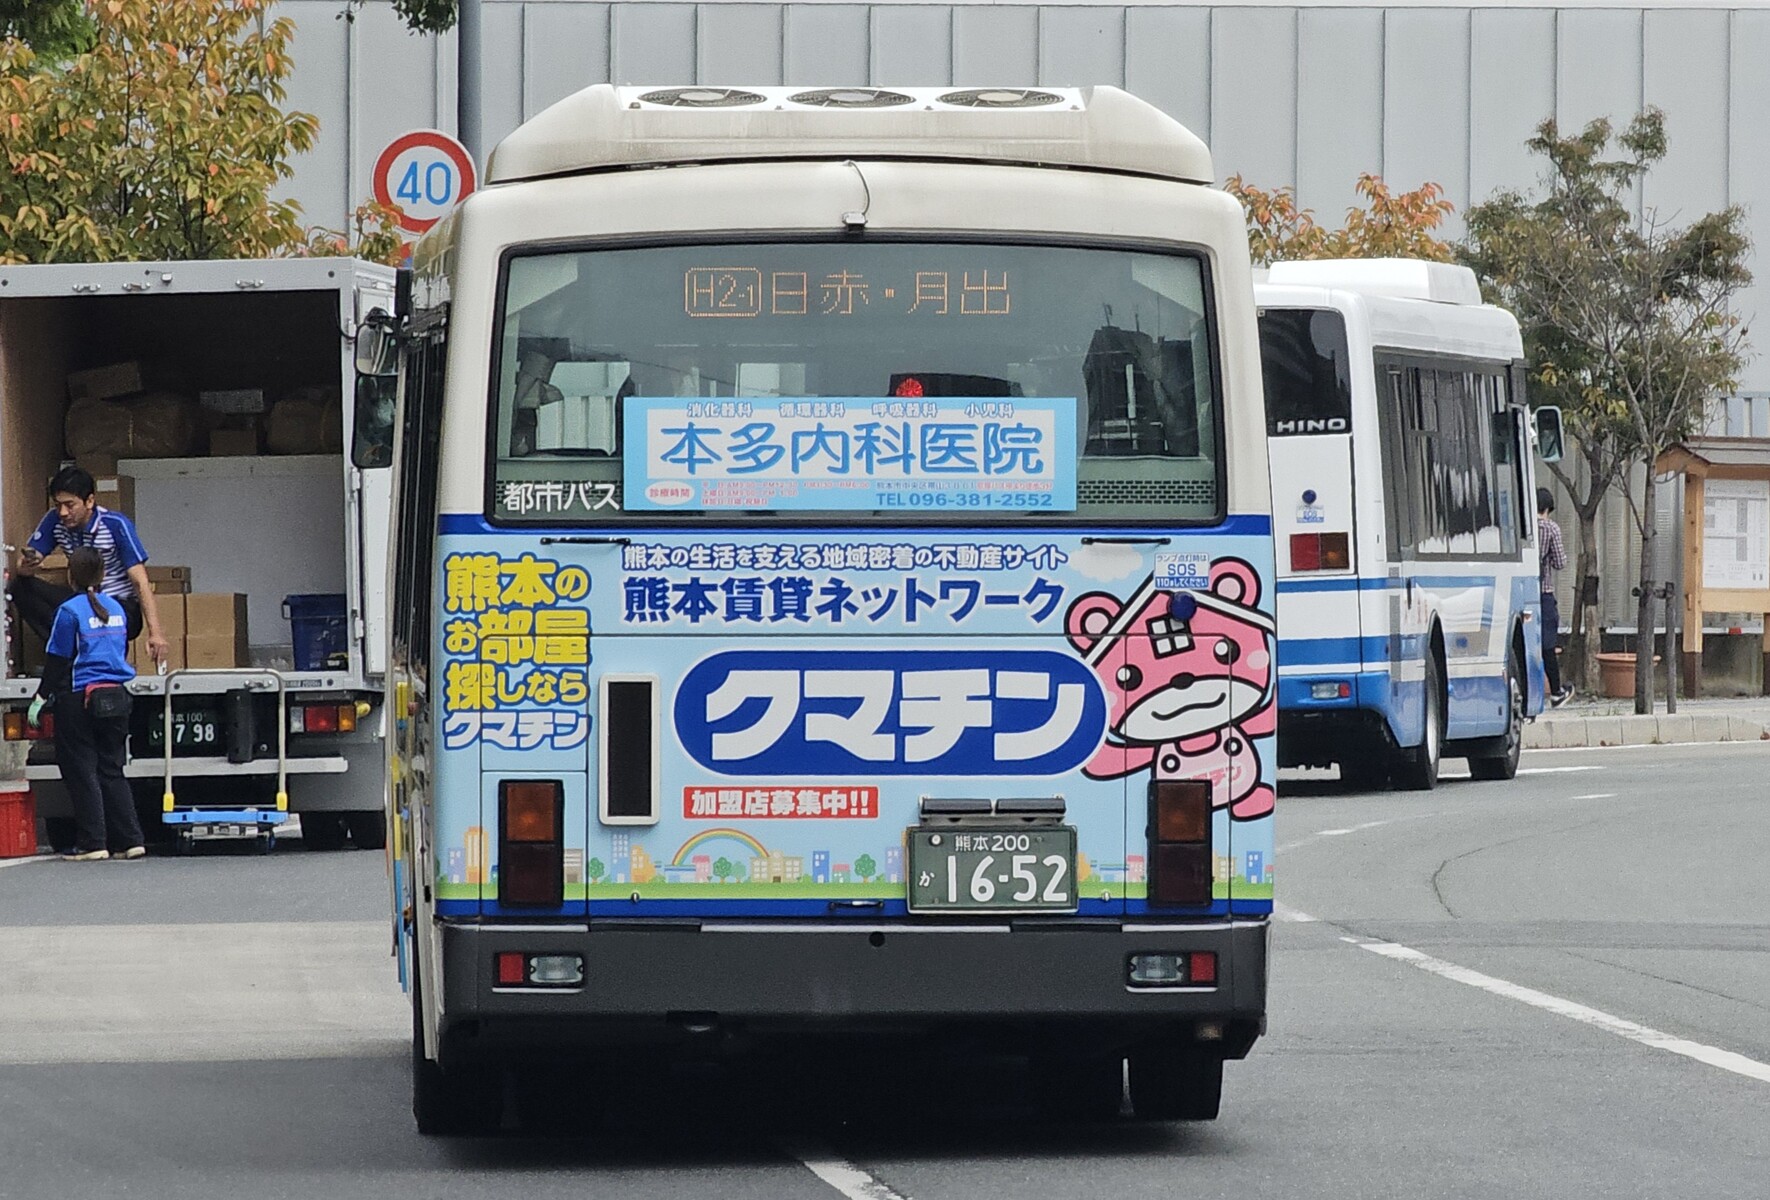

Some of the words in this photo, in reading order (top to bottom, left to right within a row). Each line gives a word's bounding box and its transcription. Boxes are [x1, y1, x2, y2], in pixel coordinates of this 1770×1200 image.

[396, 161, 452, 206] 40
[771, 269, 1010, 314] 日赤・月出
[687, 402, 753, 418] 消化器科
[779, 402, 846, 418] 循環器科
[872, 402, 938, 418] 呼吸器科
[964, 402, 1014, 418] 小児科
[1276, 417, 1347, 433] HINO
[660, 421, 1044, 475] 本多内科医院
[502, 481, 621, 512] 都市バス
[649, 487, 691, 498] 診療時間
[623, 544, 1067, 570] 熊本の生活を支える地域密着の不動産サイト
[1167, 563, 1197, 576] SOS
[444, 554, 591, 611] 熊本の
[623, 576, 1065, 623] 熊本賃貸ネットワーク
[444, 609, 590, 664] お部屋
[445, 663, 589, 712] 探しなら
[444, 711, 590, 749] クマチン
[706, 668, 1085, 762] クマチン
[955, 834, 1030, 852] 熊本200
[918, 870, 935, 887] か
[947, 855, 1068, 903] 16-52
